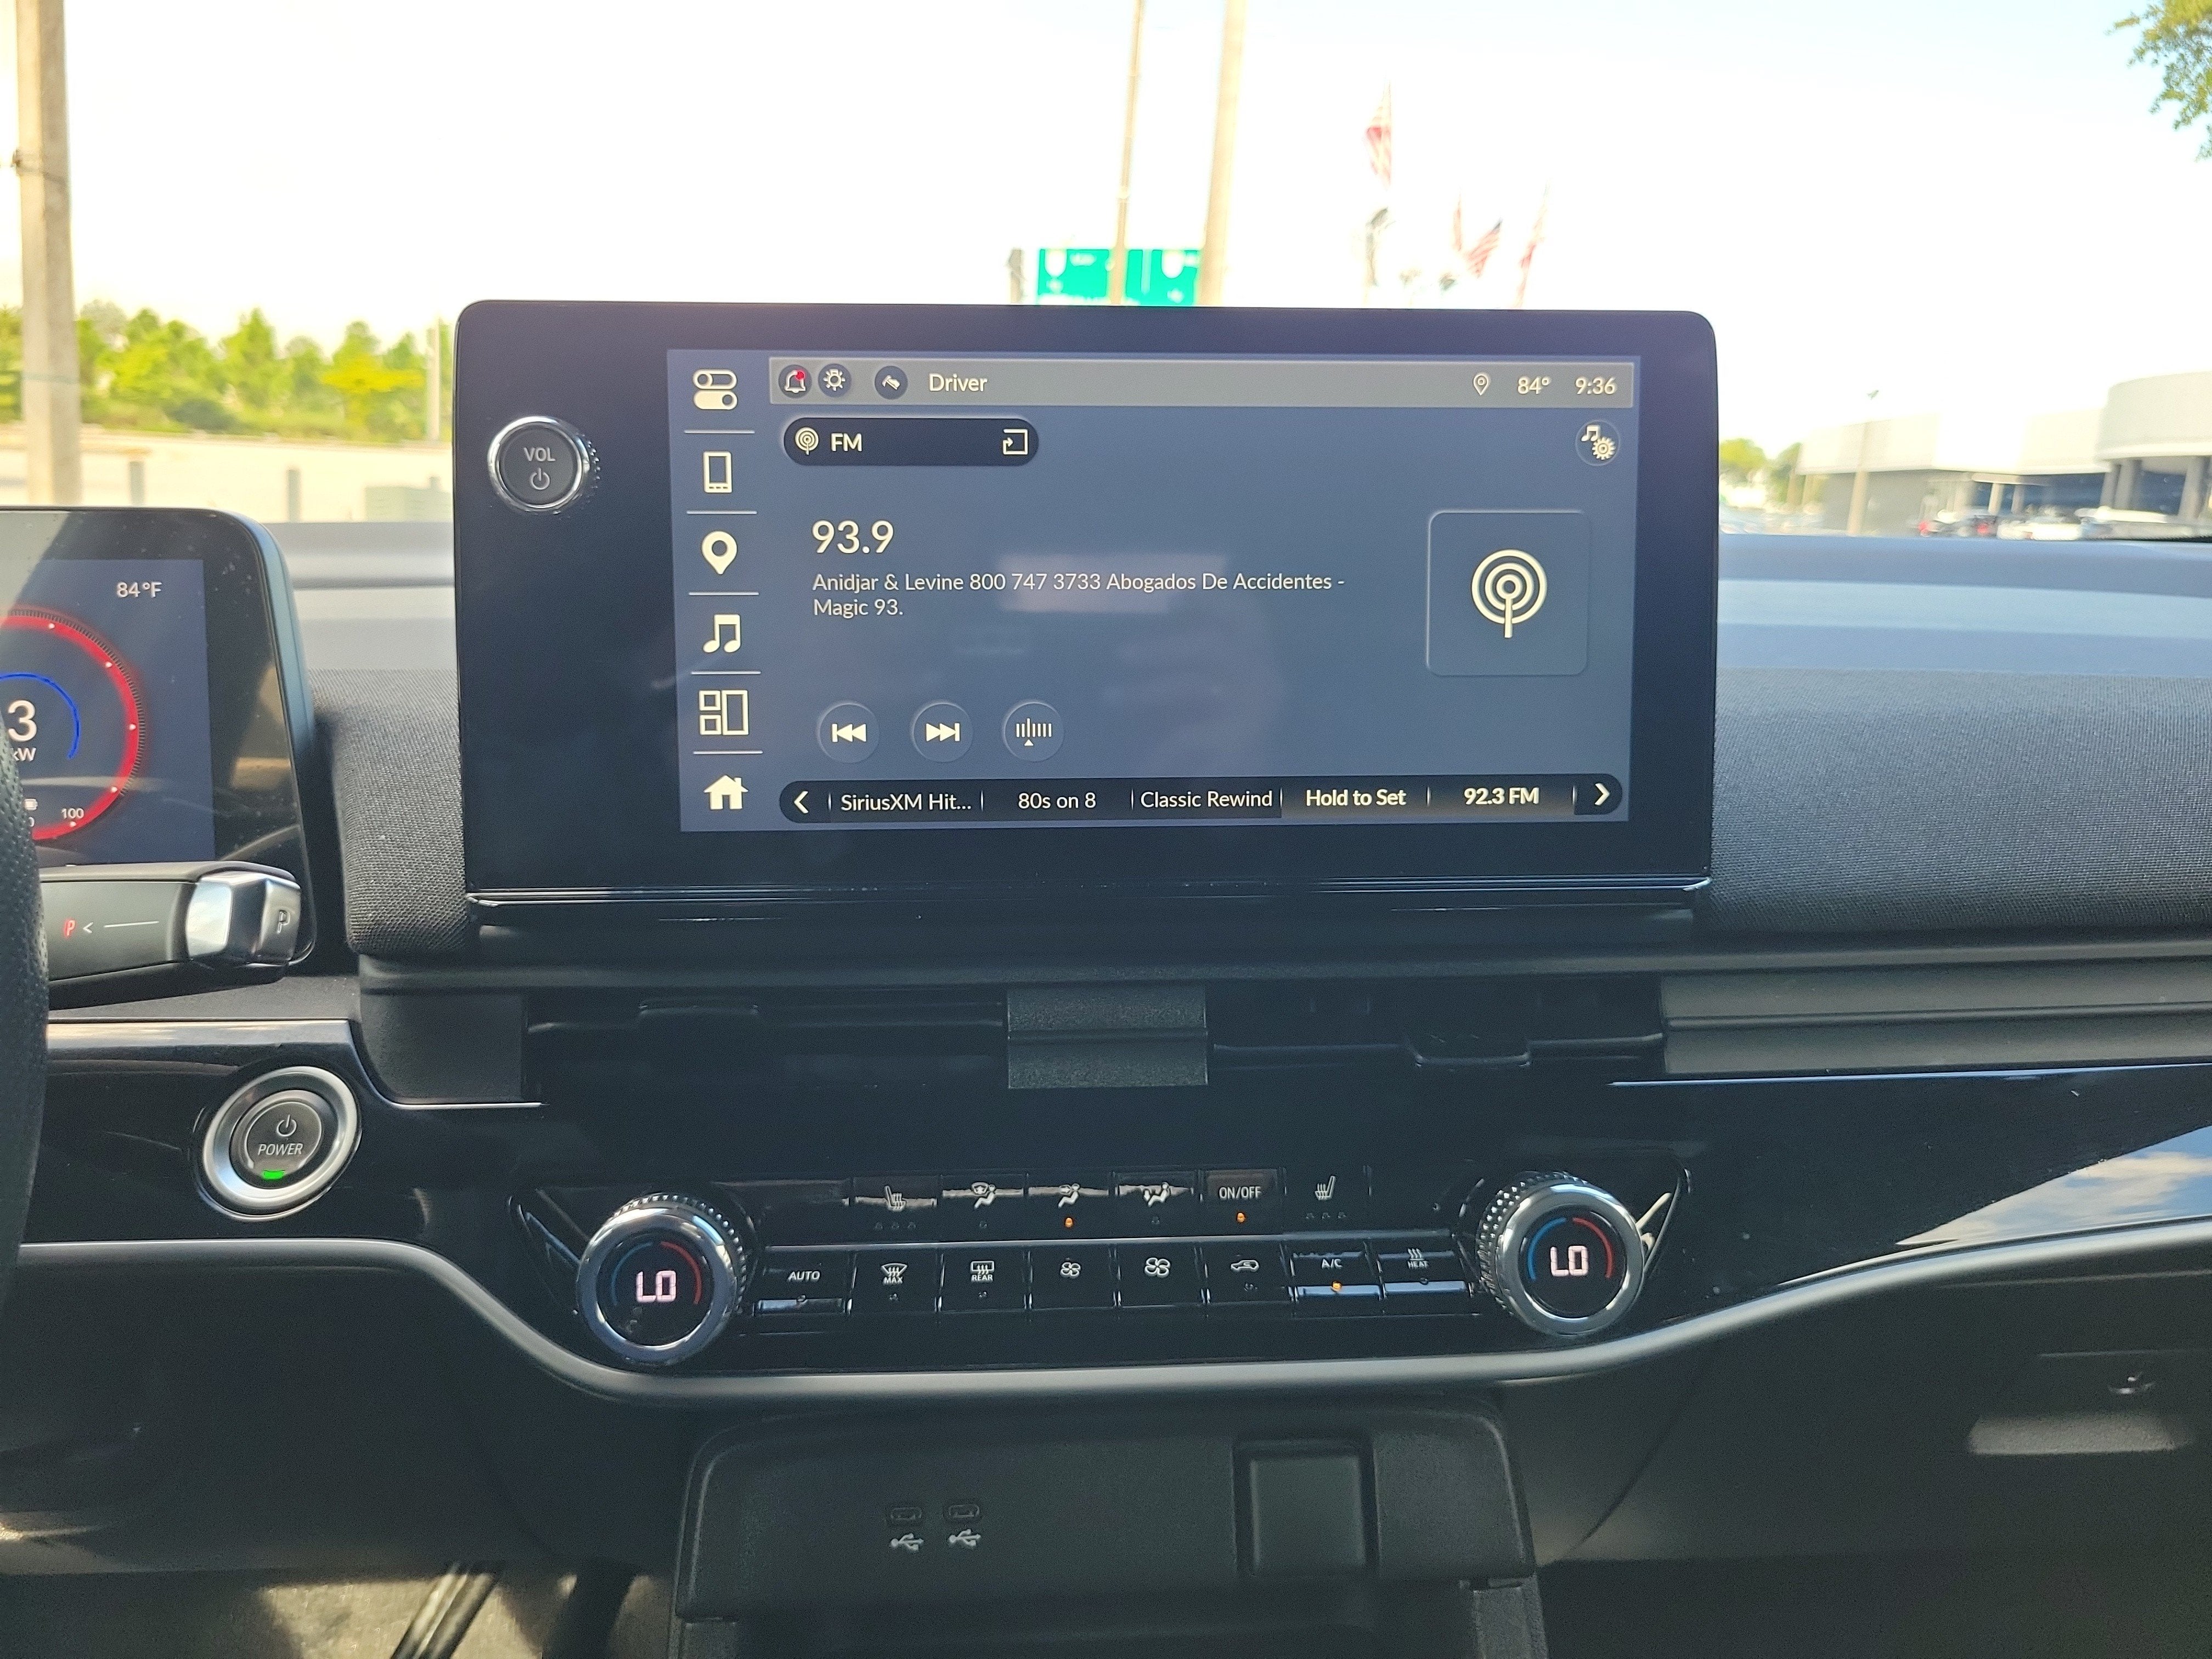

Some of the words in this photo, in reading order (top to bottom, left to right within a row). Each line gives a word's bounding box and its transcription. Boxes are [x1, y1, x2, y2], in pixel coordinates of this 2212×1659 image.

[929, 374, 988, 392] Driver
[1575, 376, 1616, 394] 9:36
[831, 433, 863, 452] FM
[523, 447, 556, 461] VOL
[812, 520, 894, 554] 93.9
[812, 573, 879, 594] Anidjar
[884, 574, 899, 591] &
[905, 574, 963, 591] Levine
[969, 573, 1006, 590] 800
[1012, 573, 1047, 590] 747
[1053, 573, 1101, 590] 3733
[1106, 573, 1196, 593] Abogados
[1203, 573, 1228, 590] De
[1233, 573, 1331, 590] Accidentes
[814, 599, 868, 619] Magic
[874, 599, 904, 616] 93.
[8, 699, 37, 742] 3
[840, 793, 922, 811] SiriusXM
[1018, 793, 1051, 809] 80s
[1057, 795, 1079, 809] on
[1085, 793, 1096, 808] 8
[1141, 791, 1201, 808] Classic
[1207, 790, 1272, 808] Rewind
[1306, 789, 1348, 806] Hold
[1353, 790, 1372, 806] to
[1376, 789, 1406, 805] Set
[1464, 787, 1504, 805] 92.3
[1509, 787, 1539, 804] FM
[61, 808, 84, 819] 100
[64, 918, 77, 937] P
[278, 910, 290, 933] P
[258, 1143, 303, 1155] POWER
[1218, 1186, 1261, 1199] ON/OFF
[1321, 1258, 1342, 1269] A/C
[788, 1269, 821, 1282] AUTO
[883, 1276, 904, 1284] MAX
[971, 1273, 994, 1282] REAR
